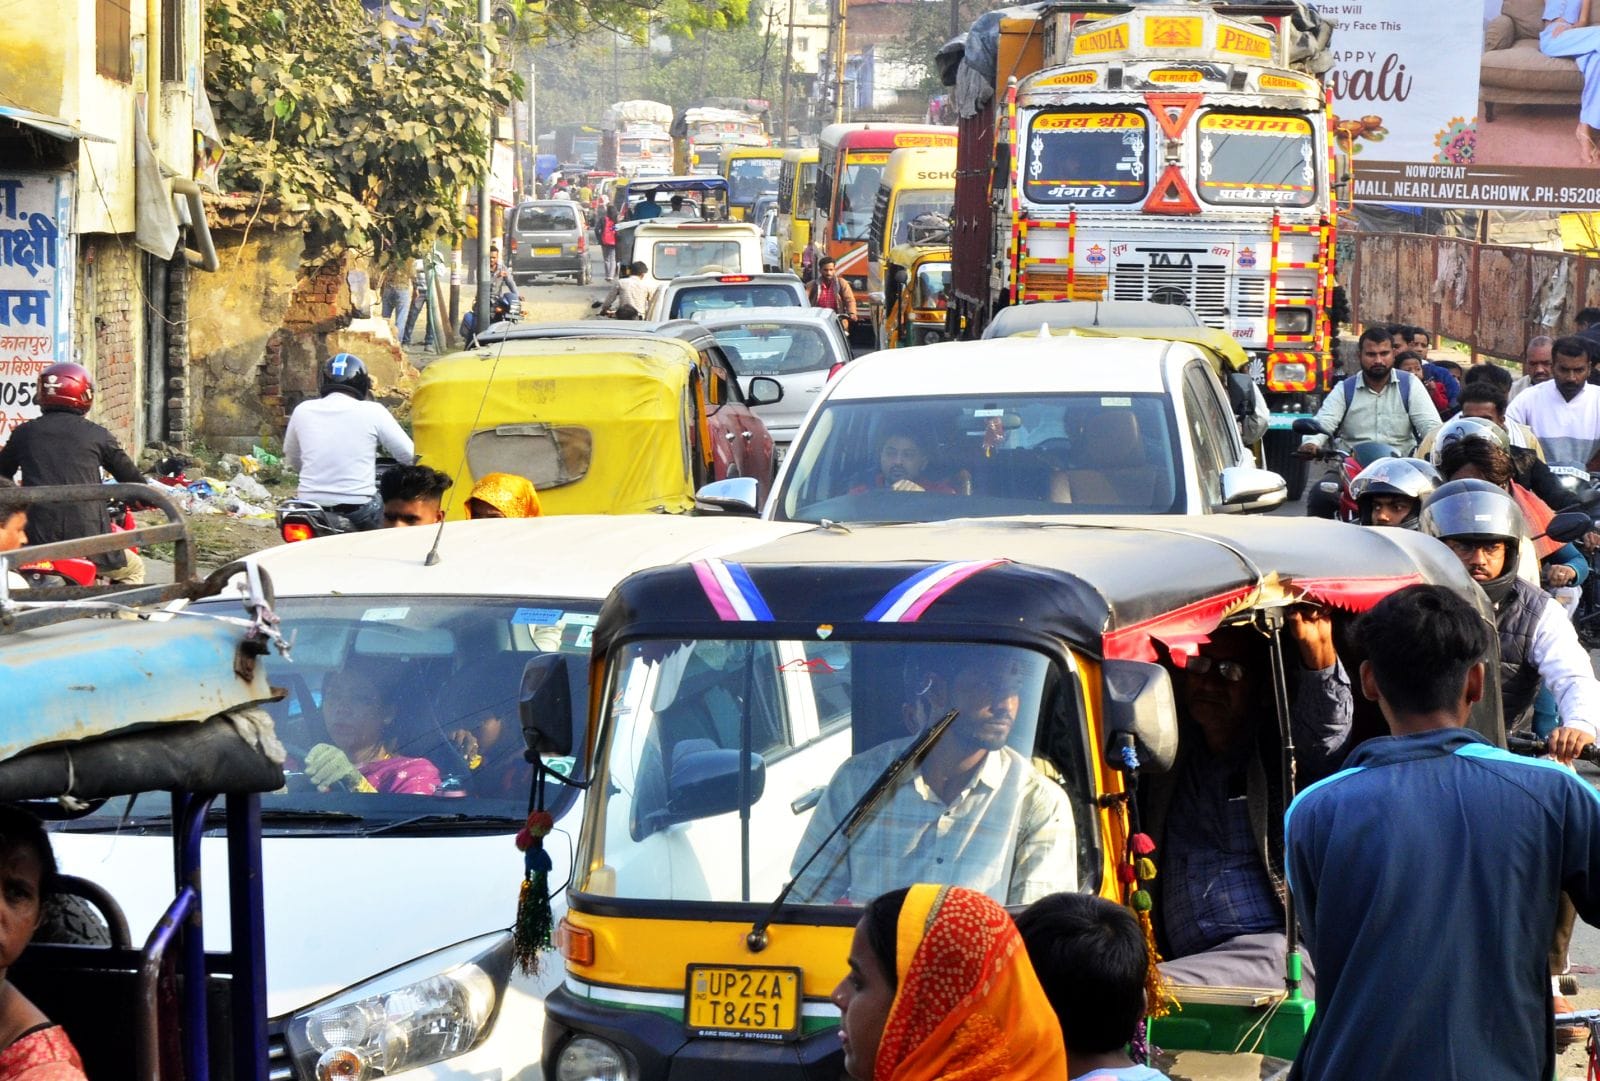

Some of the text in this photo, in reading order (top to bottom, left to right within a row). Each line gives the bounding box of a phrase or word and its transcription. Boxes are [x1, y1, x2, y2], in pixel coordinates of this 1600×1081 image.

[1342, 6, 1362, 14] Will
[1333, 21, 1401, 31] ery Face This
[1089, 28, 1126, 51] INDIA
[1222, 28, 1267, 53] PERMIT
[1333, 51, 1376, 62] APPY
[1053, 73, 1094, 84] GOODS
[1051, 114, 1128, 128] जय श्री
[1219, 118, 1290, 131] श्याम
[1405, 165, 1467, 179] NOW OPEN AT
[1047, 185, 1091, 198] गंगा
[1354, 180, 1393, 197] MALL,
[1394, 181, 1430, 198] NEAR
[1481, 184, 1530, 201] CHOWK
[1149, 253, 1193, 266] TAA
[11, 356, 55, 376] विशेष
[710, 972, 782, 999] UP24A
[710, 1001, 779, 1027] T8451
